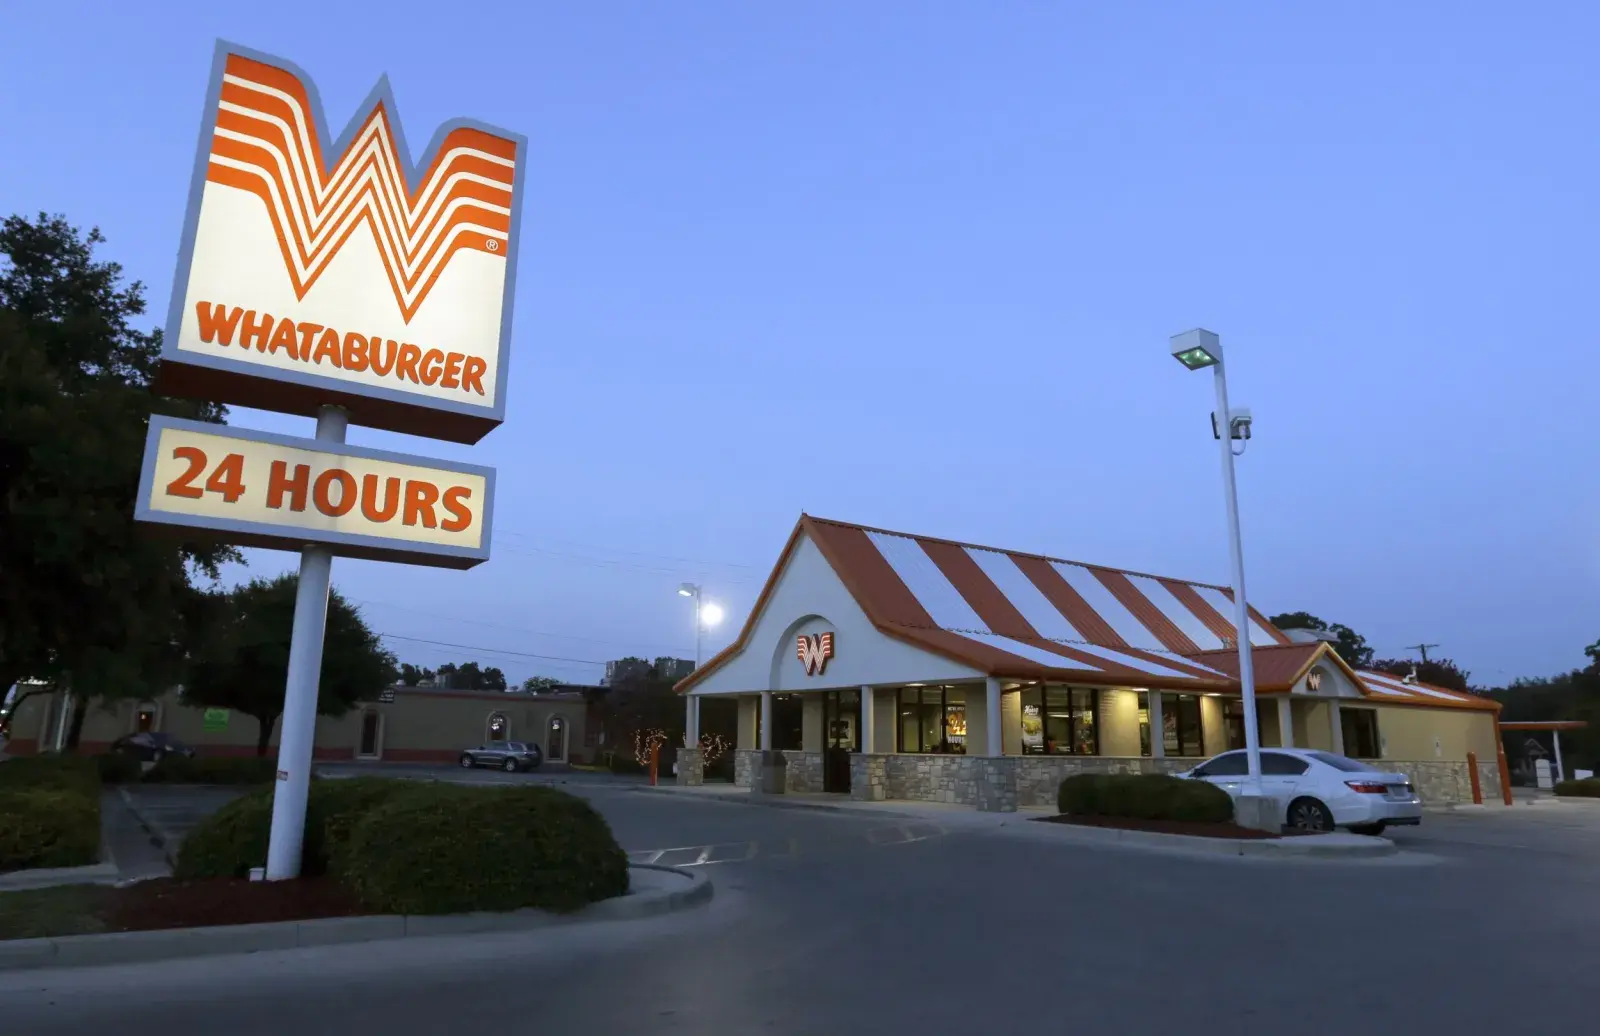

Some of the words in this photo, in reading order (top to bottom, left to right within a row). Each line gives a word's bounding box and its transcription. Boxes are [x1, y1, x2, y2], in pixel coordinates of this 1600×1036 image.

[207, 54, 516, 323] W
[196, 301, 487, 396] WHATABURGER
[166, 446, 246, 503] 24
[266, 460, 473, 533] HOURS
